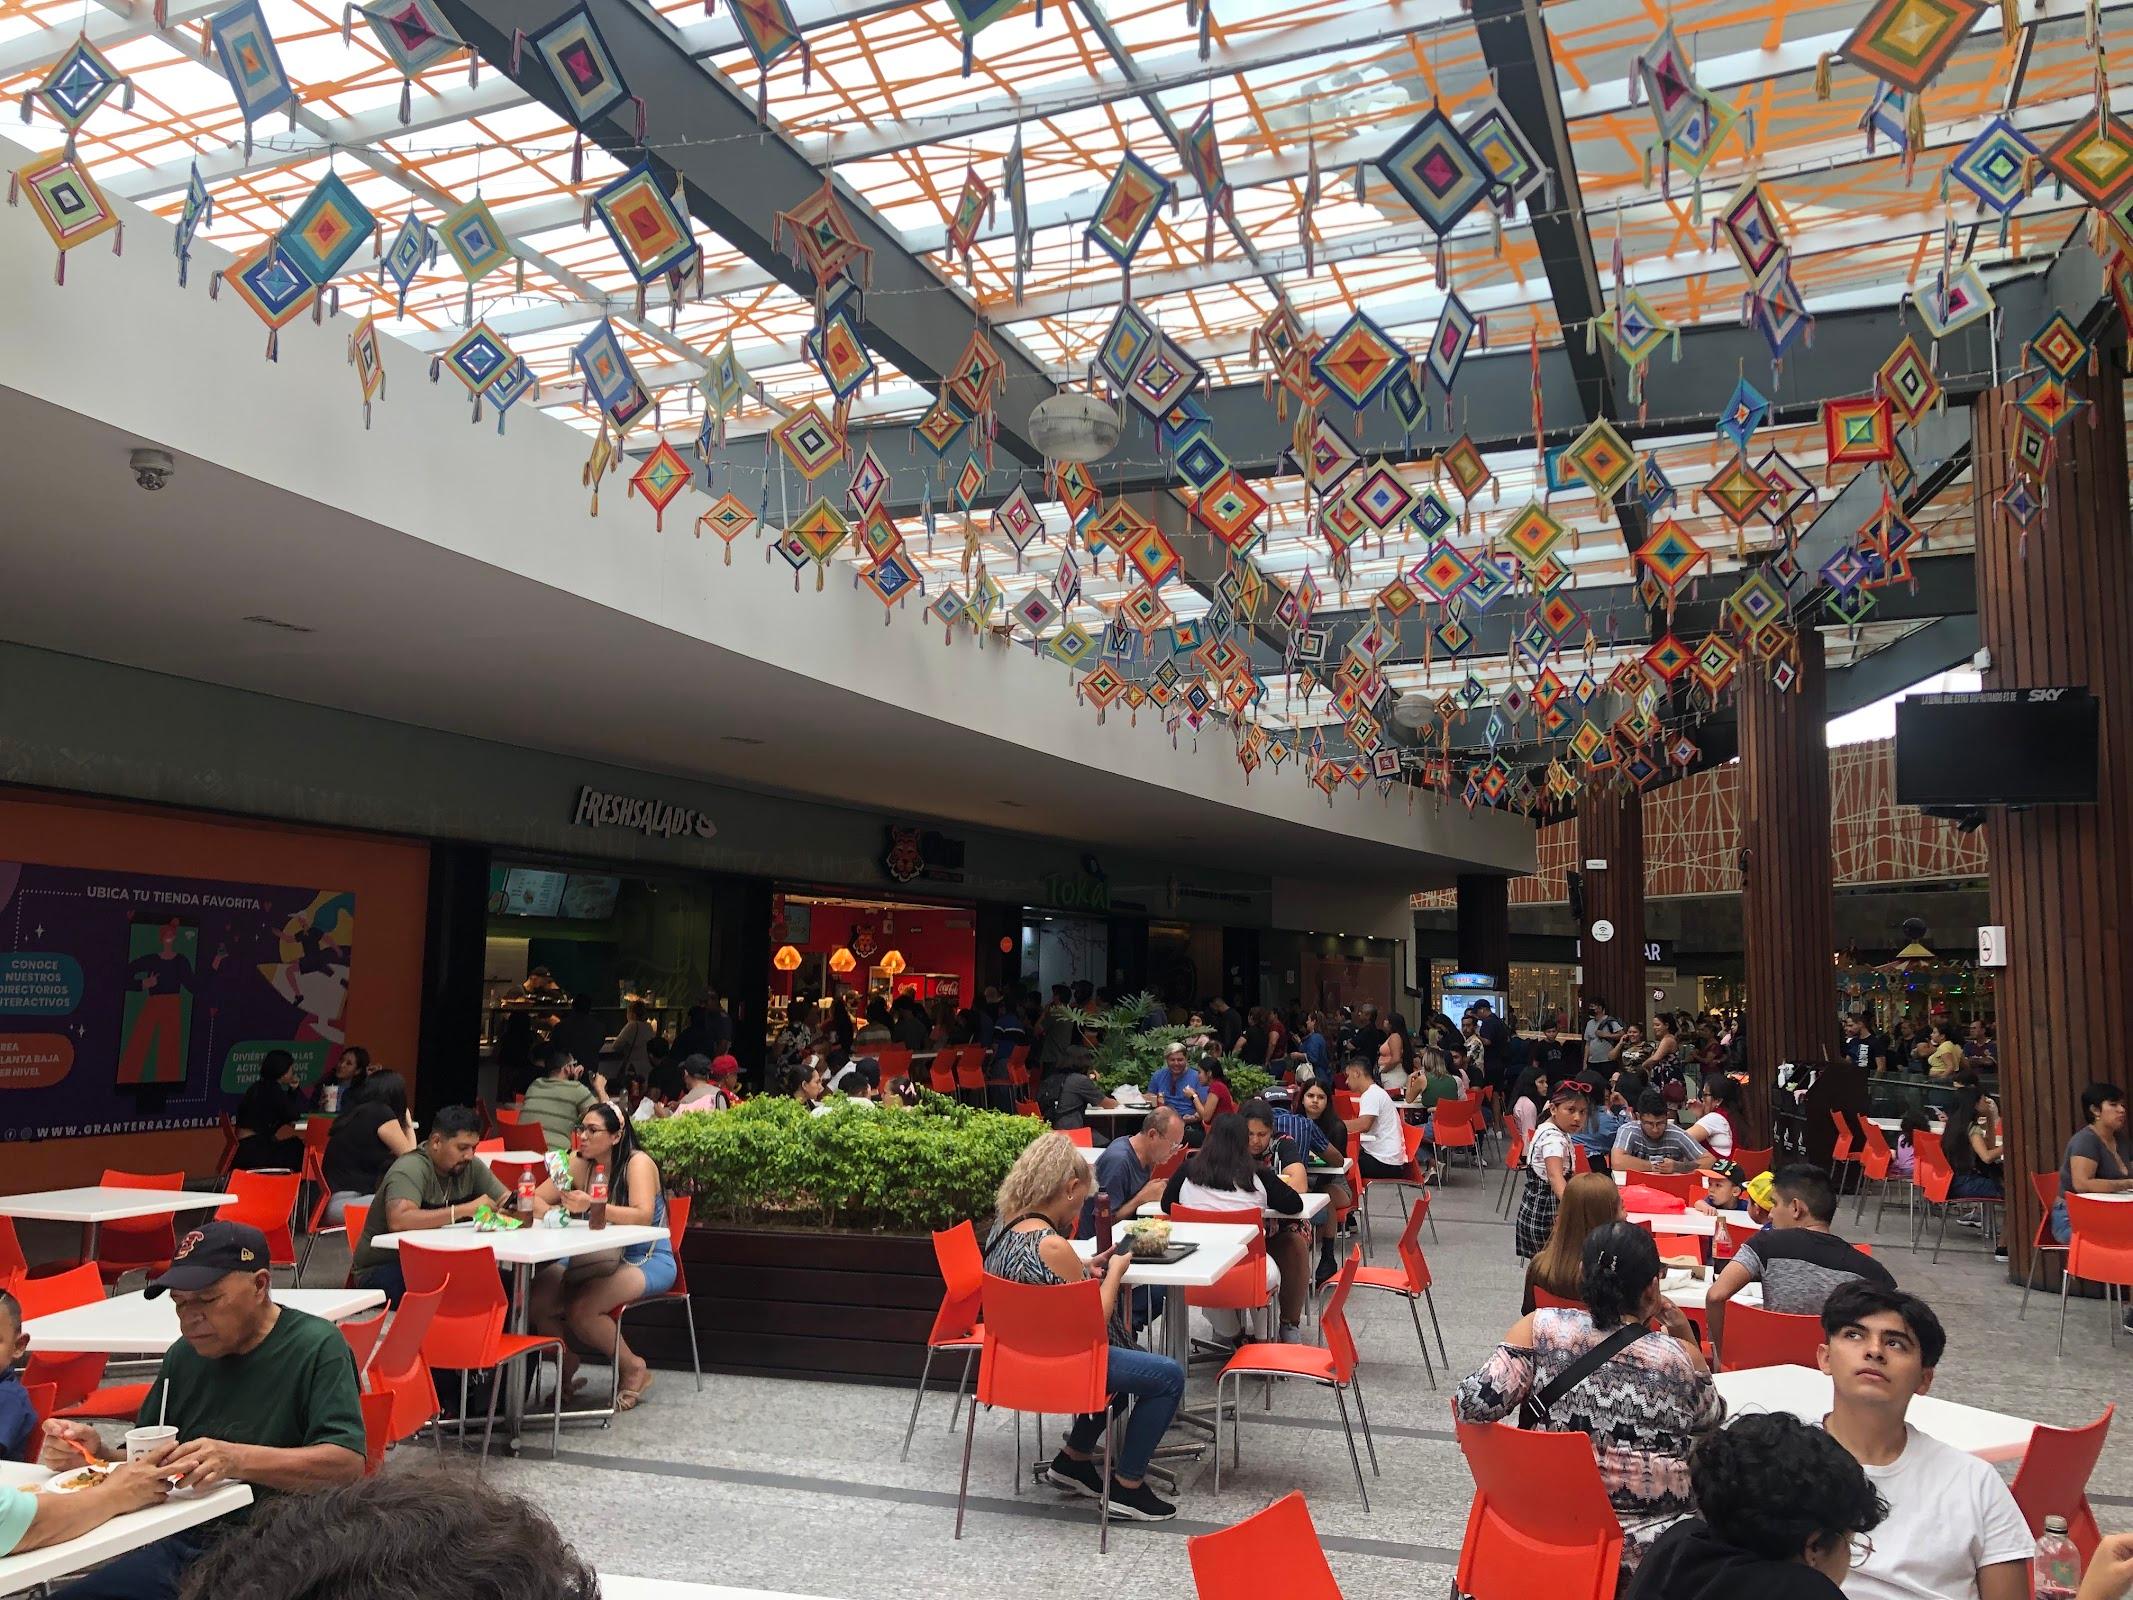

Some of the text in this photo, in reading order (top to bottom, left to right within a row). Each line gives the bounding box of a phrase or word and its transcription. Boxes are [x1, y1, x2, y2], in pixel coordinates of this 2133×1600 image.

[2028, 688, 2064, 703] SKY
[575, 785, 696, 839] FRESHSALADS
[87, 886, 261, 910] UBICA TU TIENDA FAVORITA
[11, 960, 59, 970] CONOCE
[5, 972, 62, 982] NUESTROS
[33, 1054, 60, 1063] BAJA
[36, 1115, 238, 1138] WWW.GRANTERRAZAOBLATS
